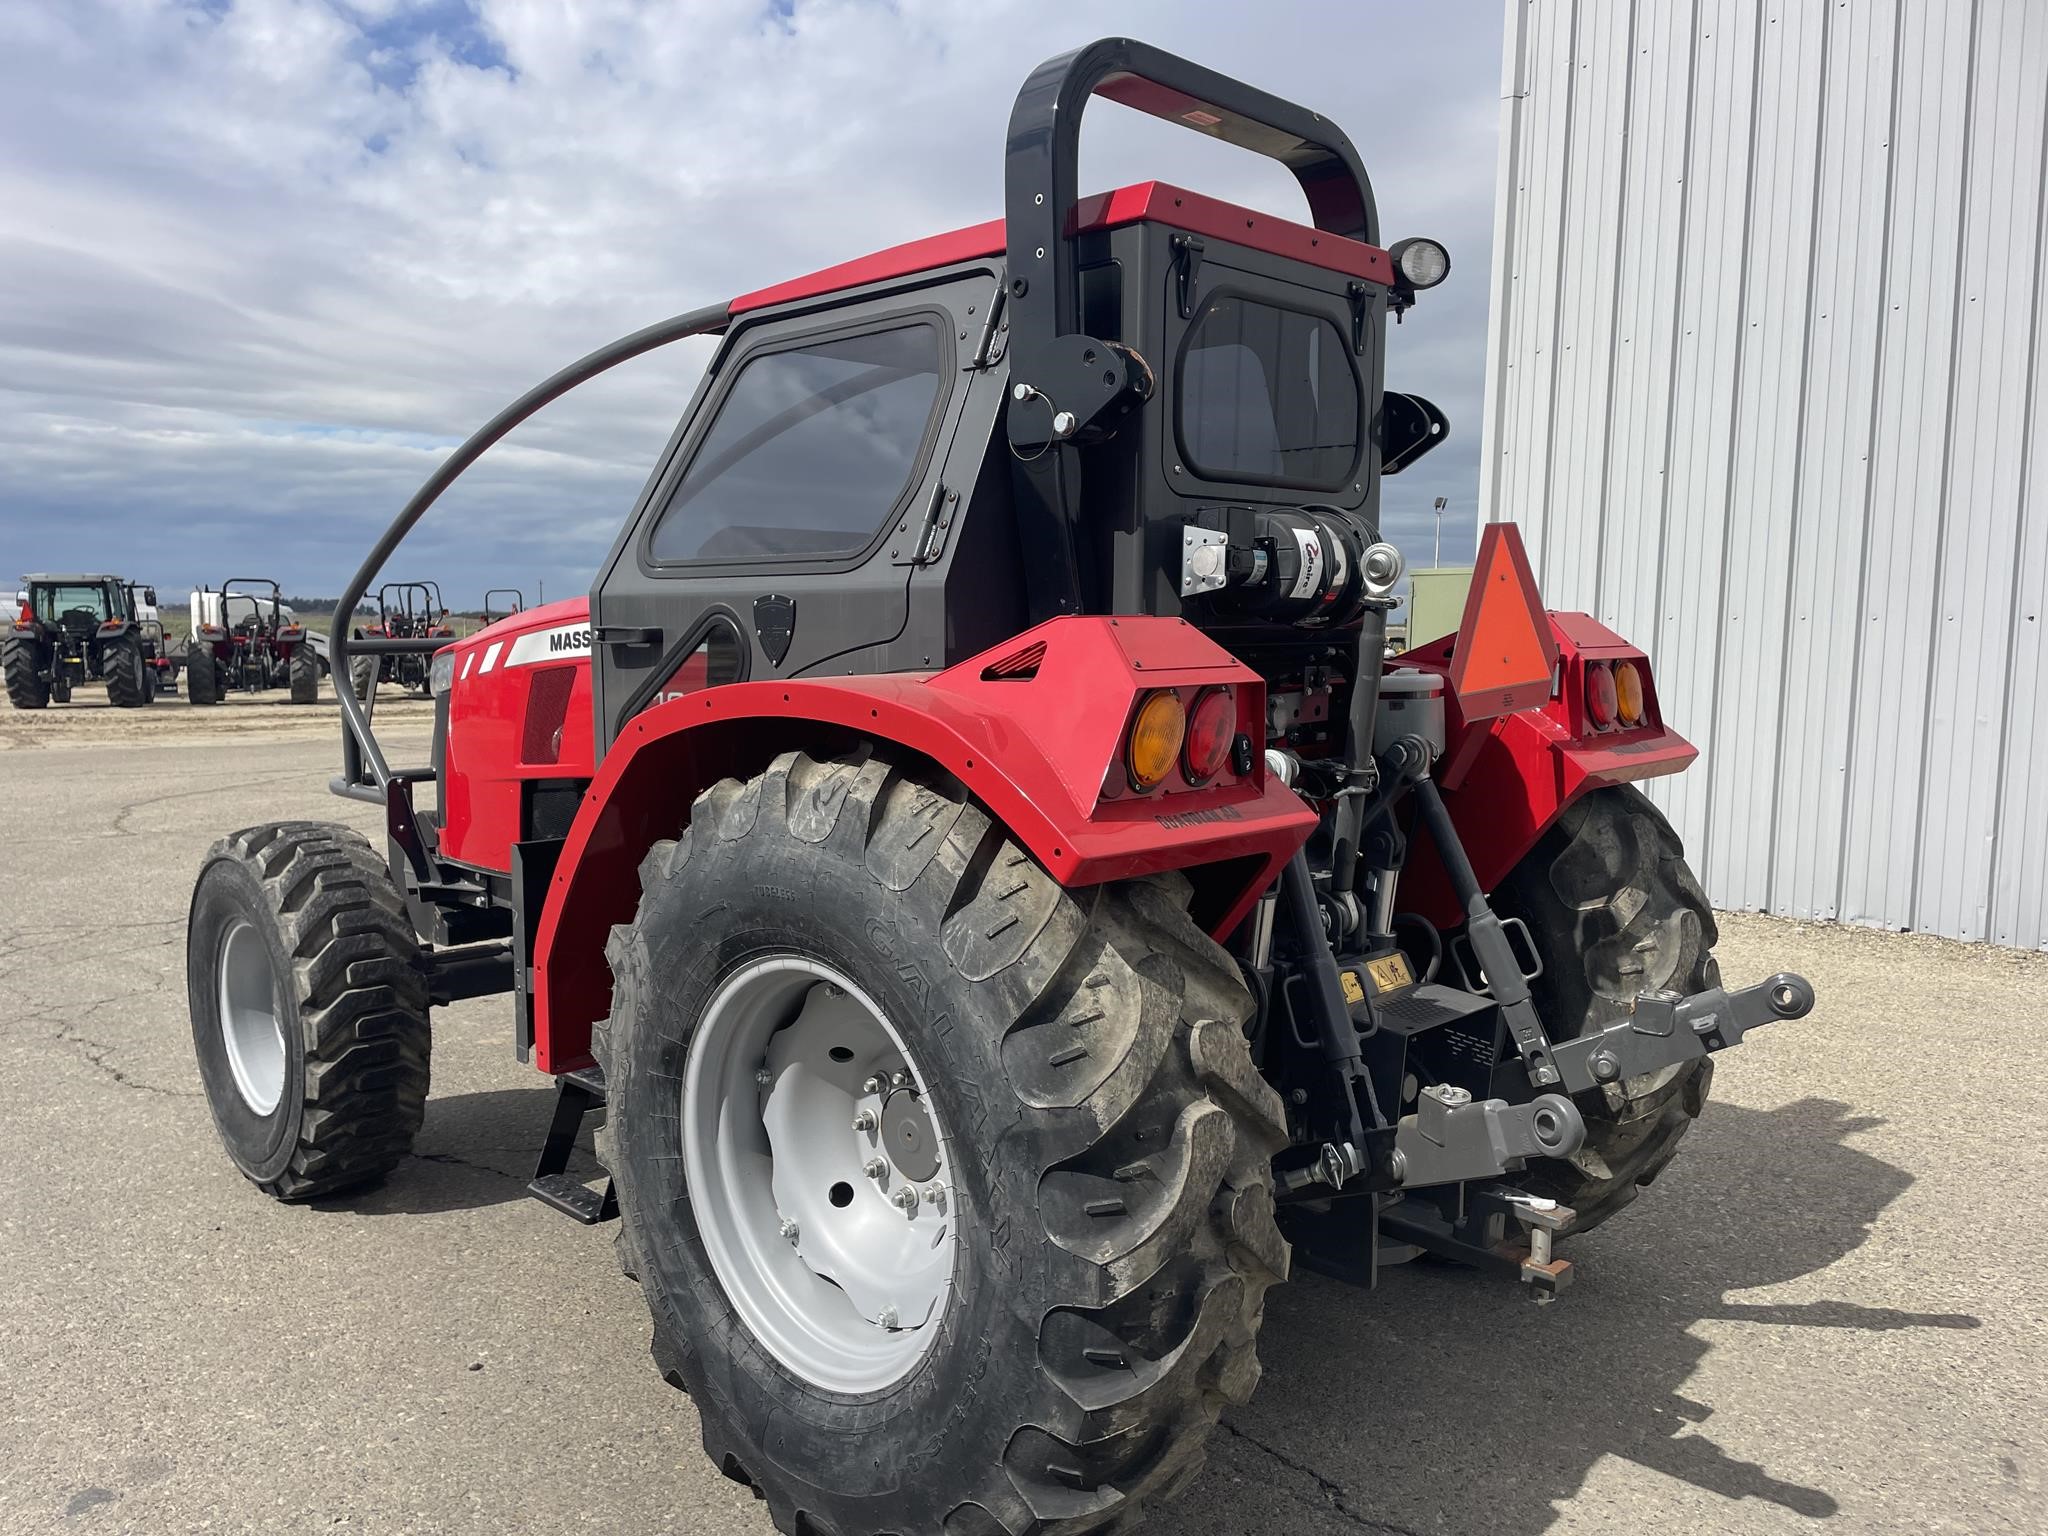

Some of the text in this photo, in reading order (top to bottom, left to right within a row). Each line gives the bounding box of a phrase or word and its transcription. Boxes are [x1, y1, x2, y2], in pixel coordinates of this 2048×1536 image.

[549, 630, 591, 652] MASS
[754, 885, 797, 903] TUBELESS
[865, 915, 1014, 1274] GALAXY
